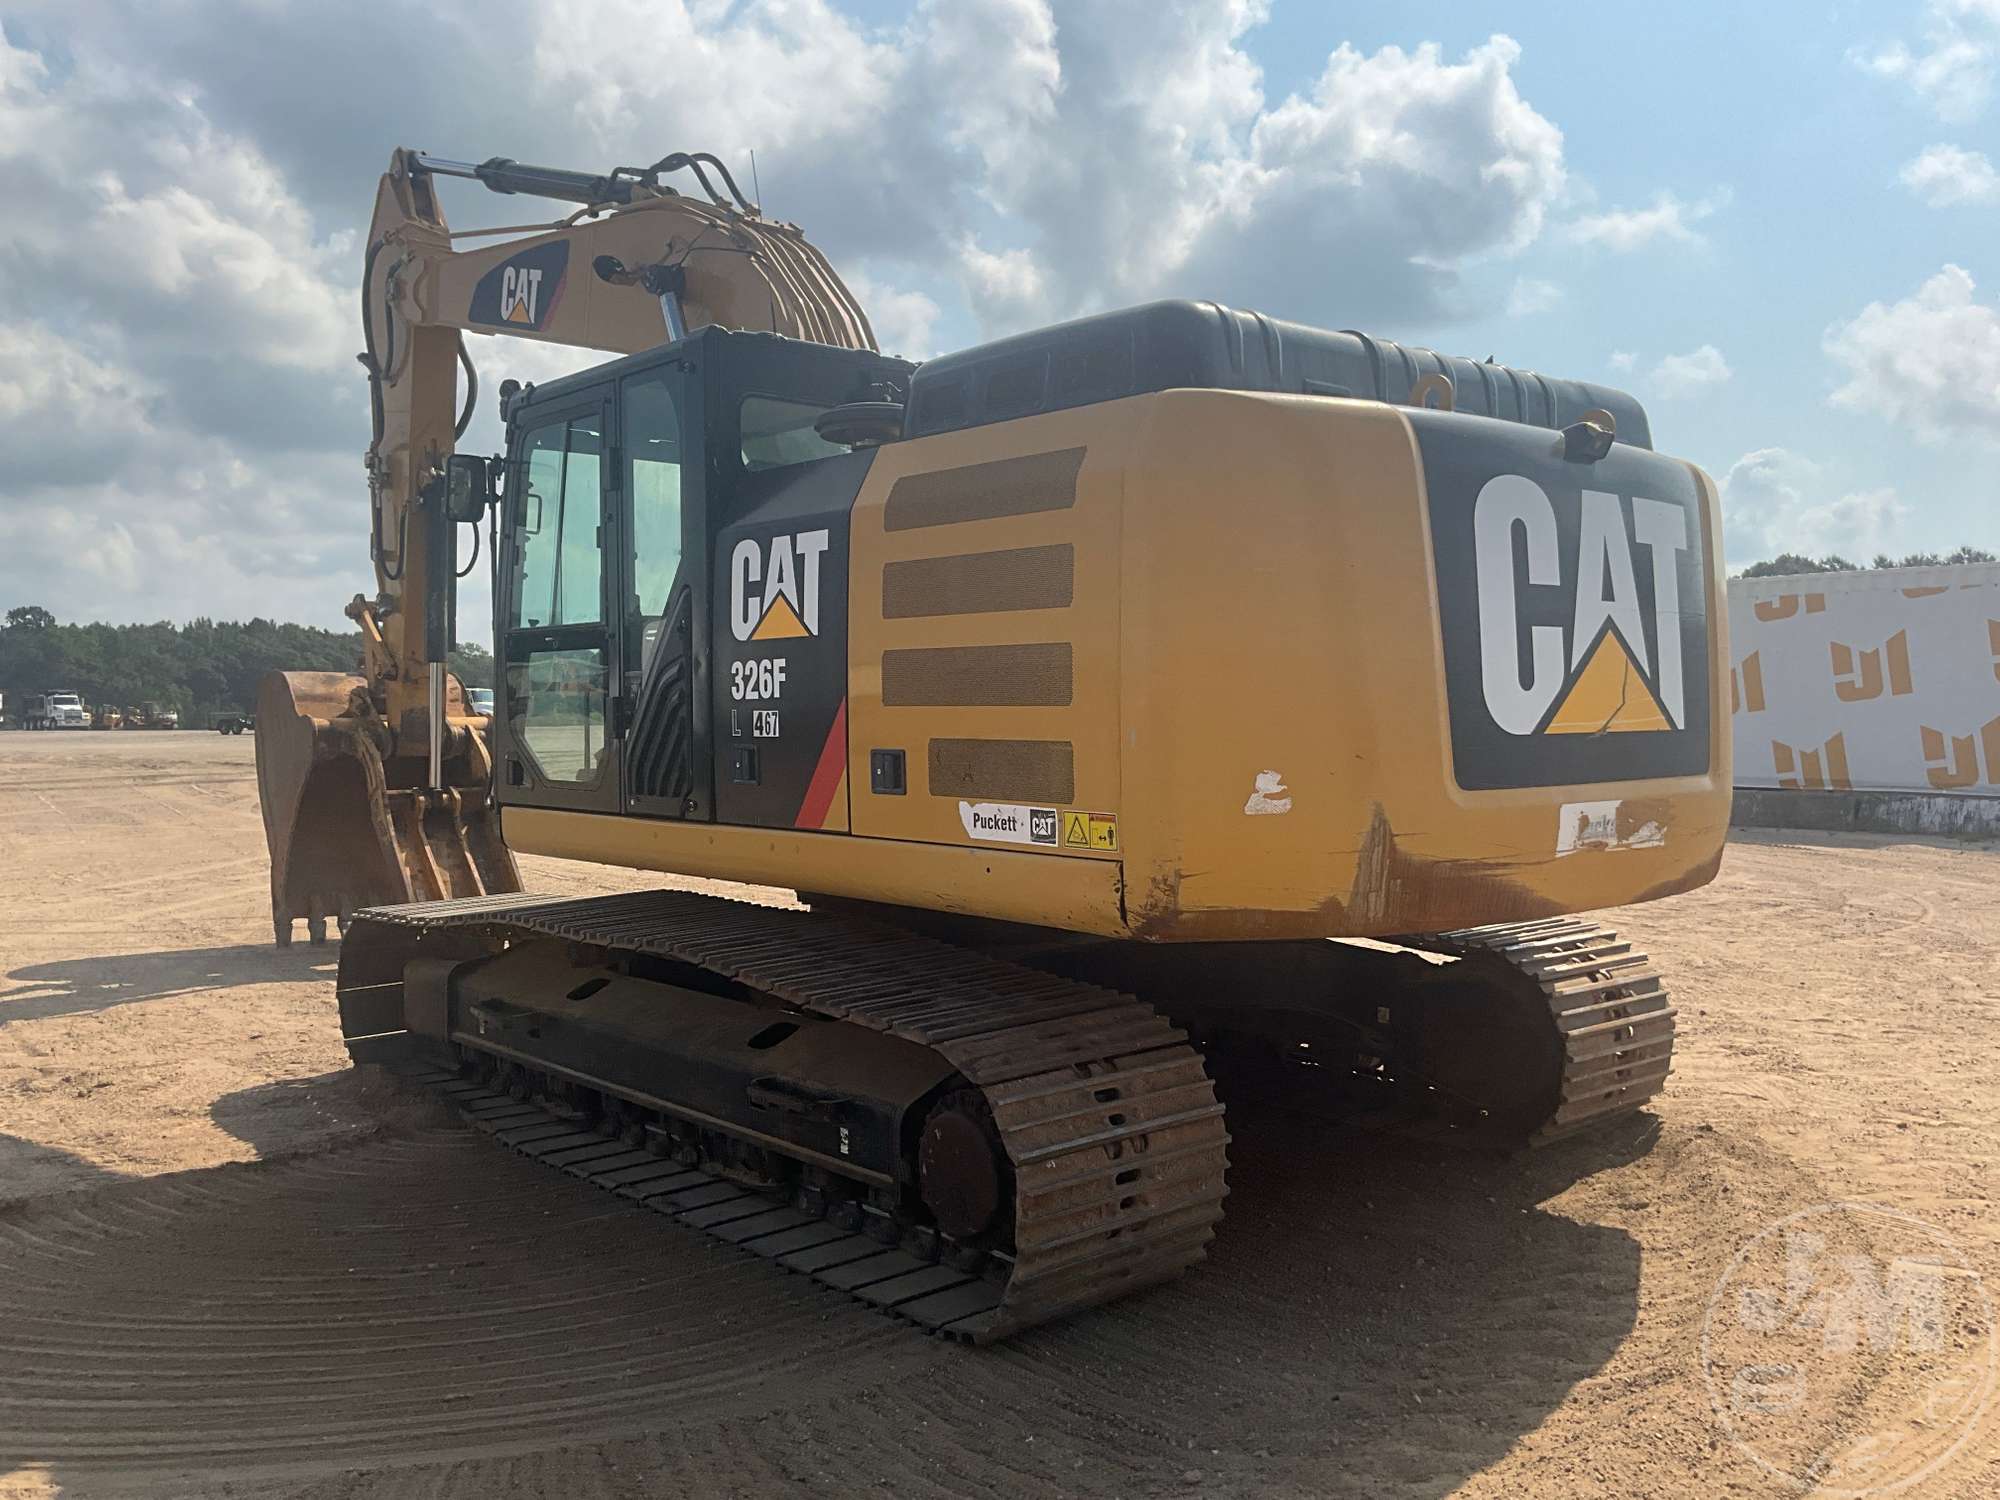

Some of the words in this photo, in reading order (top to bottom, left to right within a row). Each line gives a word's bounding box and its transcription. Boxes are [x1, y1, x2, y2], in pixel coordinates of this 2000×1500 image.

[501, 266, 542, 324] CAT
[731, 529, 829, 642] CAT
[1474, 474, 1687, 735] CAT
[731, 658, 786, 700] 326F
[731, 709, 742, 737] L
[754, 711, 779, 736] 467
[973, 812, 1018, 832] Puckett
[1031, 816, 1055, 836] CAT
